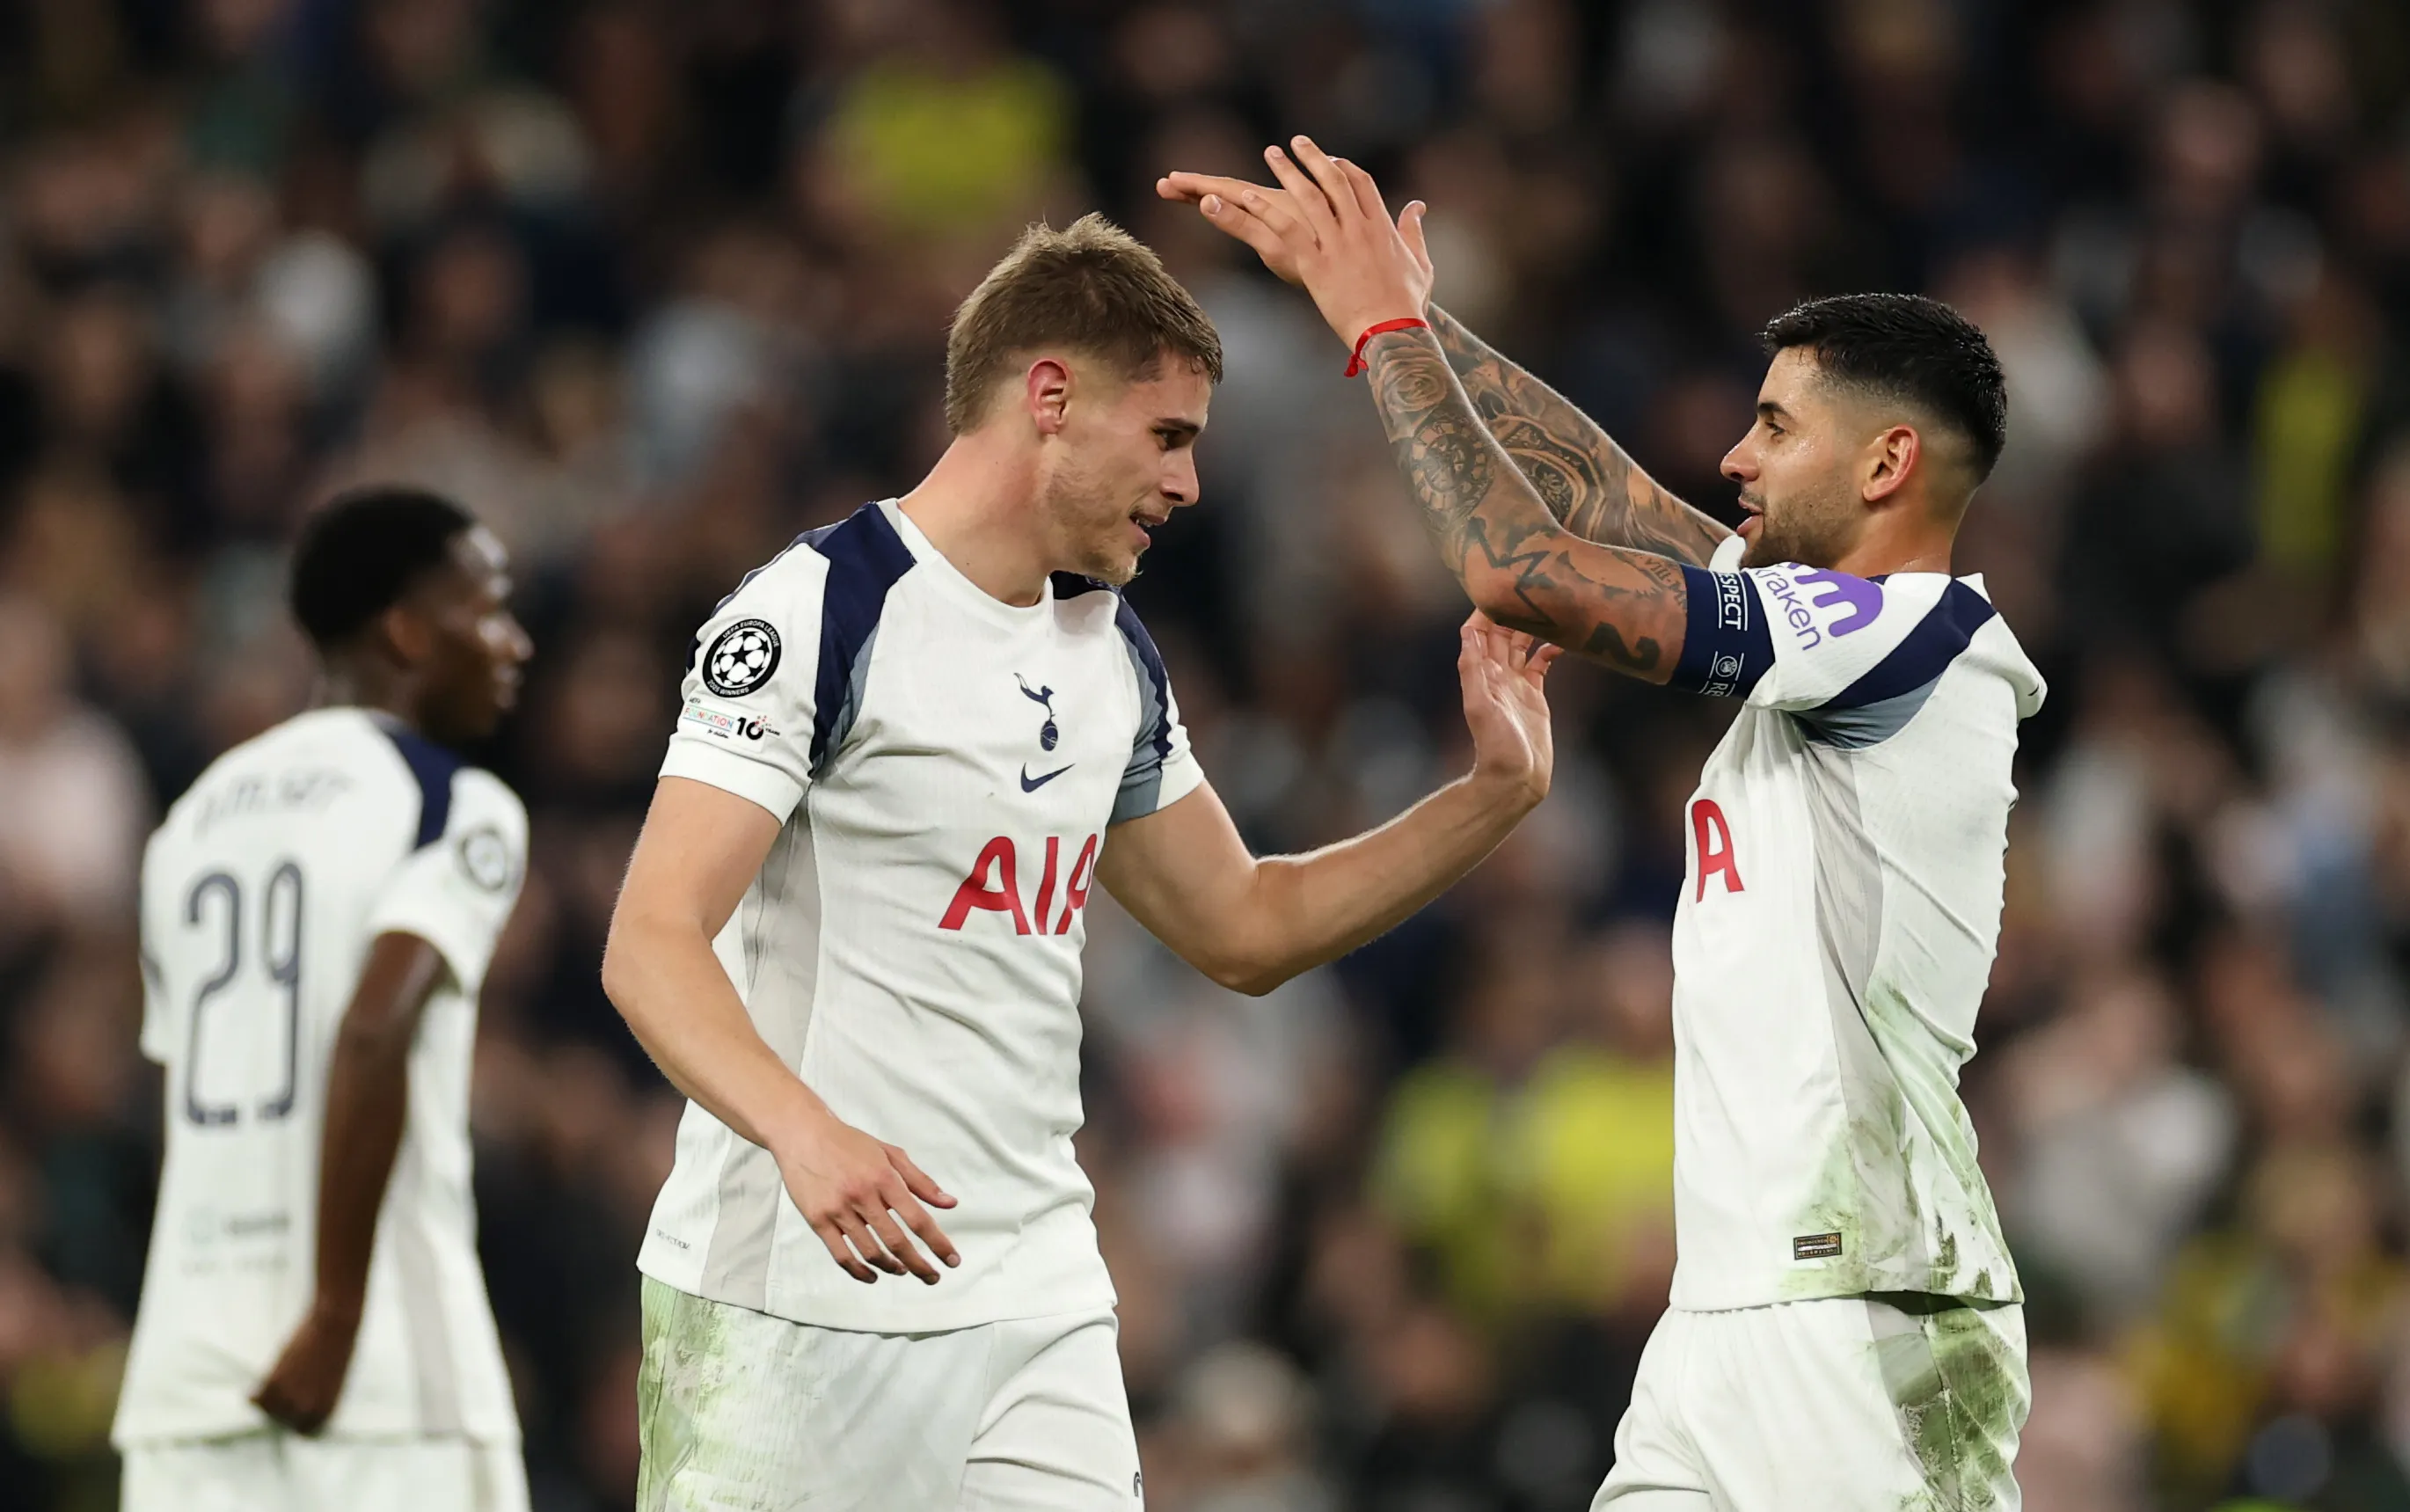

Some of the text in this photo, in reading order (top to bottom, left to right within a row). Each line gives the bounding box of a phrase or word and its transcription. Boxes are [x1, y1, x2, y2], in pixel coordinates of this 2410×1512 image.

[1718, 573, 1742, 631] ESPECT
[722, 625, 739, 638] UEFA
[764, 625, 779, 647] LEAGUE
[736, 716, 764, 741] 10
[938, 833, 1098, 936] AIA
[185, 859, 303, 1128] 29
